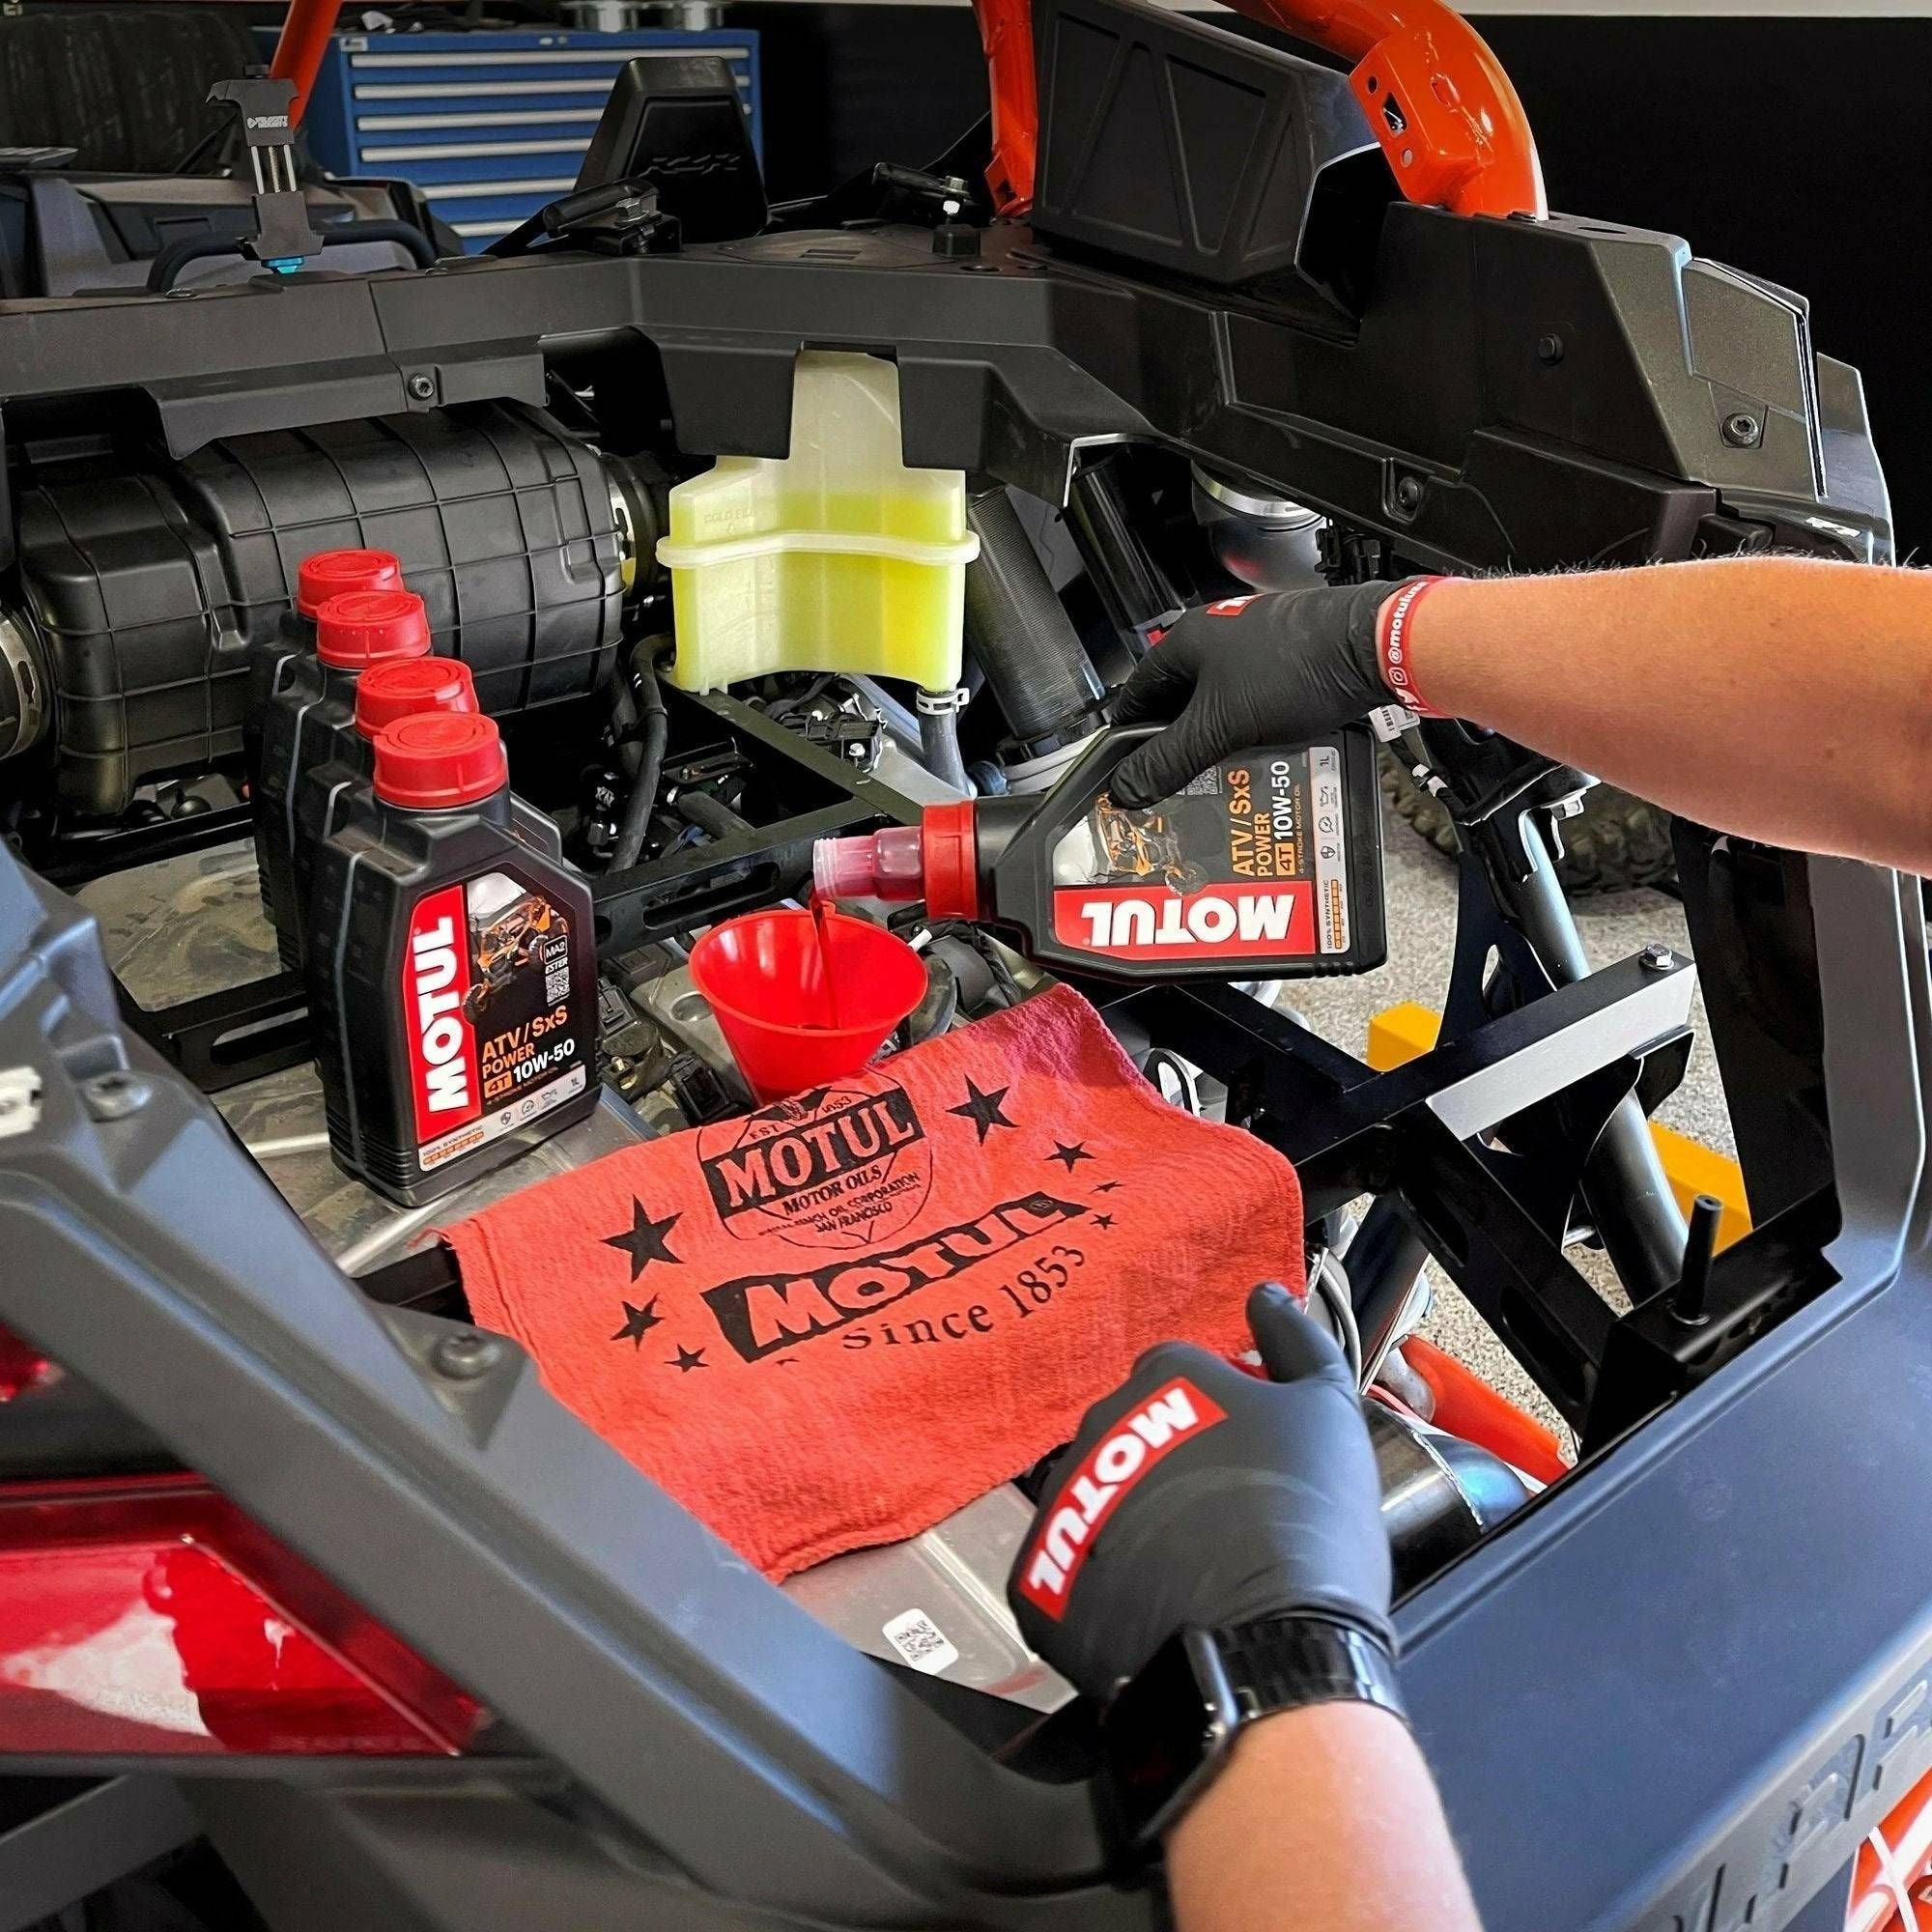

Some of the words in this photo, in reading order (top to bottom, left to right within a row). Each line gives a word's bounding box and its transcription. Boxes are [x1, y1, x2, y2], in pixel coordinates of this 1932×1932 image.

[1228, 769, 1252, 814] SxS
[1270, 761, 1293, 840] 10W-50
[1231, 830, 1255, 876] ATV
[1254, 812, 1273, 877] POWER
[1277, 846, 1293, 872] 4T
[546, 940, 566, 956] MA2
[1081, 895, 1293, 947] MOTUL
[545, 957, 568, 974] ESTER
[412, 917, 469, 1112] MOTUL
[482, 1027, 521, 1063] ATV
[532, 1005, 567, 1037] SxS
[482, 1043, 535, 1079] POWER
[486, 1073, 510, 1094] 4T
[514, 1038, 575, 1082] 10W-50
[716, 1100, 915, 1208] MOTUL
[781, 1180, 841, 1215] MOTOR
[846, 1164, 883, 1190] OILS
[838, 1201, 893, 1229] FRANCISCO
[745, 1206, 1068, 1349] MOTUL
[999, 1244, 1084, 1318] 1853
[1029, 1387, 1199, 1594] MOTUL
